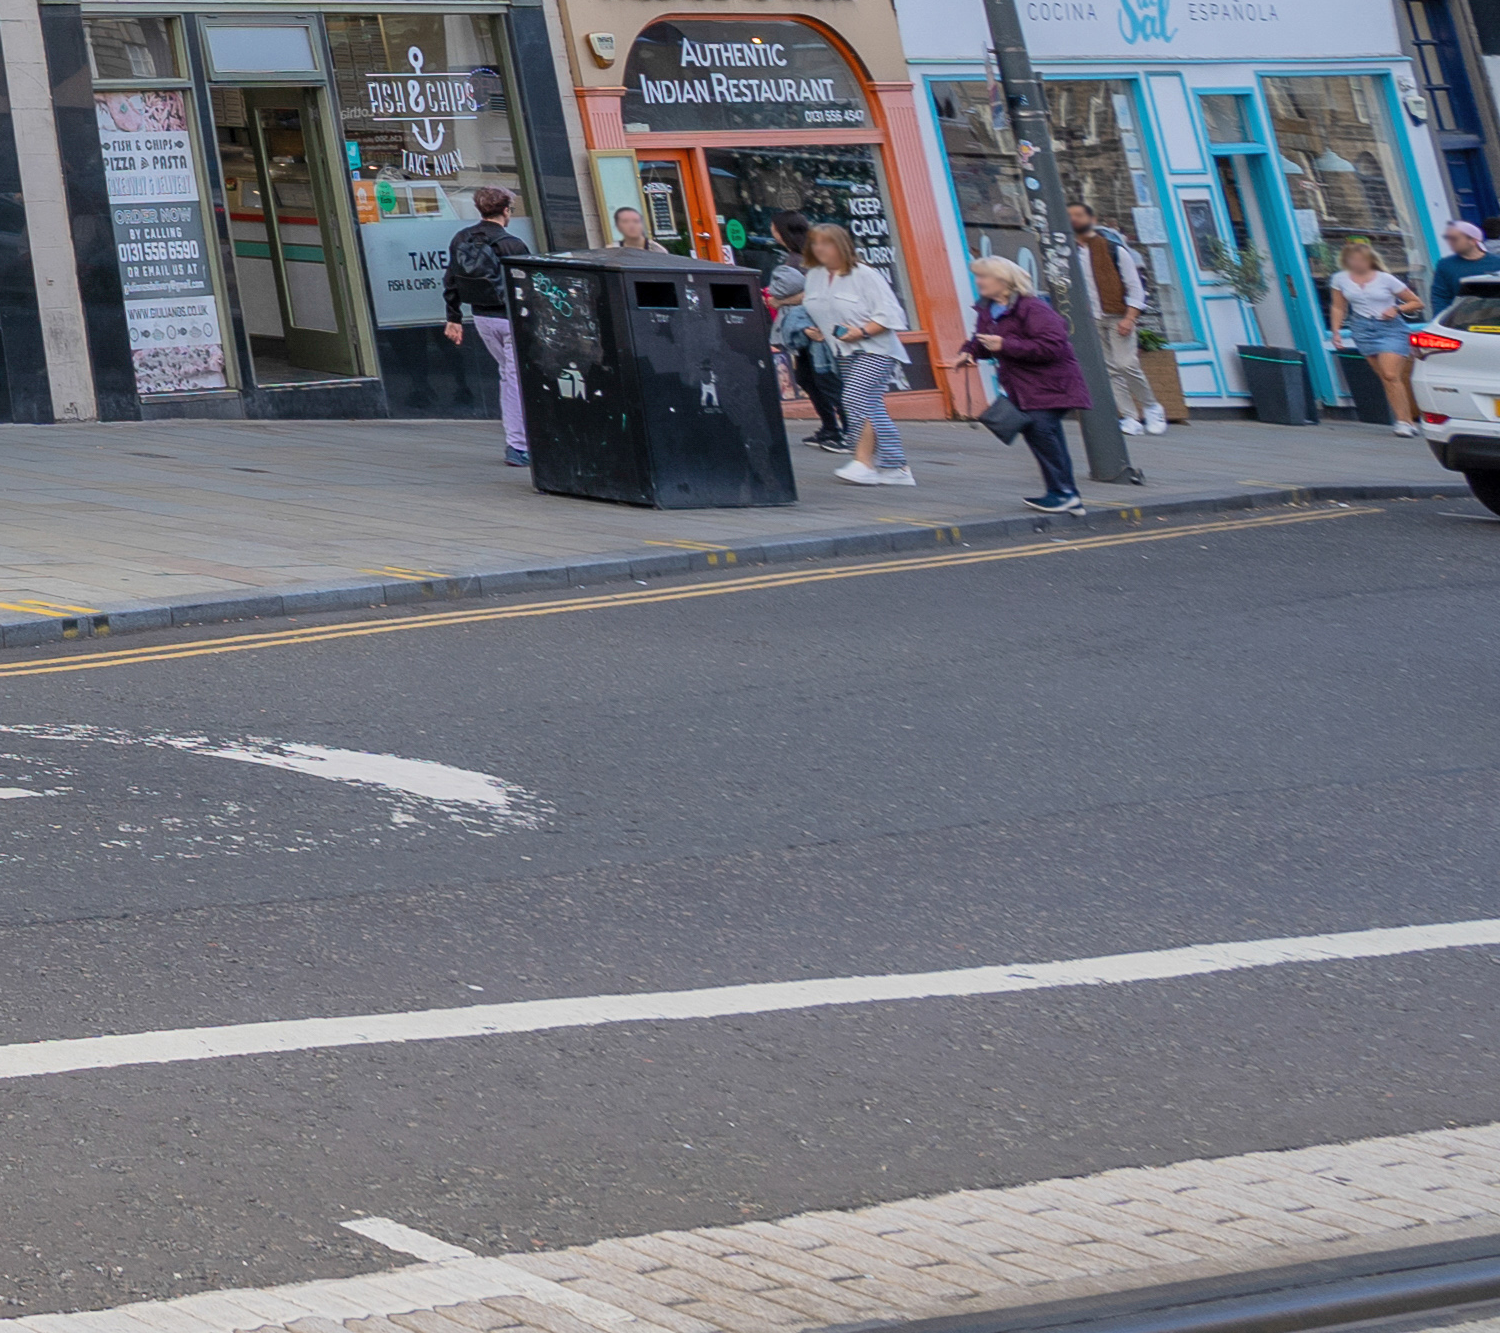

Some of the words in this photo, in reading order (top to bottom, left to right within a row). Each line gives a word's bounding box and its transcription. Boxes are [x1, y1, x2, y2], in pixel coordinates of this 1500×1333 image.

[1027, 2, 1098, 21] COCINA
[1188, 0, 1279, 22] ESPAÑOLA
[367, 81, 407, 114] FISH
[407, 79, 425, 113] &
[425, 81, 478, 112] CHIPS
[804, 110, 825, 122] 0131
[825, 110, 842, 122] 556
[843, 110, 865, 122] 4547
[112, 139, 132, 151] FISH
[135, 139, 141, 151] &
[145, 139, 173, 151] CHIPS
[103, 156, 136, 171] PIZZA
[152, 155, 187, 169] PASTA
[401, 149, 431, 177] TAKE
[433, 148, 465, 177] AWAY
[848, 197, 882, 215] KEEP
[114, 208, 159, 225] ORDER
[160, 206, 192, 223] NOW
[129, 228, 141, 240] BY
[144, 227, 182, 239] CALLING
[850, 219, 890, 237] CALM
[118, 243, 144, 262] 0131
[144, 242, 168, 261] 556
[168, 240, 200, 259] 6590
[408, 251, 448, 271] TAKE
[127, 267, 140, 278] OR
[143, 265, 170, 277] EMAIL
[172, 264, 183, 275] US
[187, 264, 198, 274] AT
[388, 280, 405, 291] FISH
[406, 279, 413, 290] &
[414, 278, 437, 290] CHIPS
